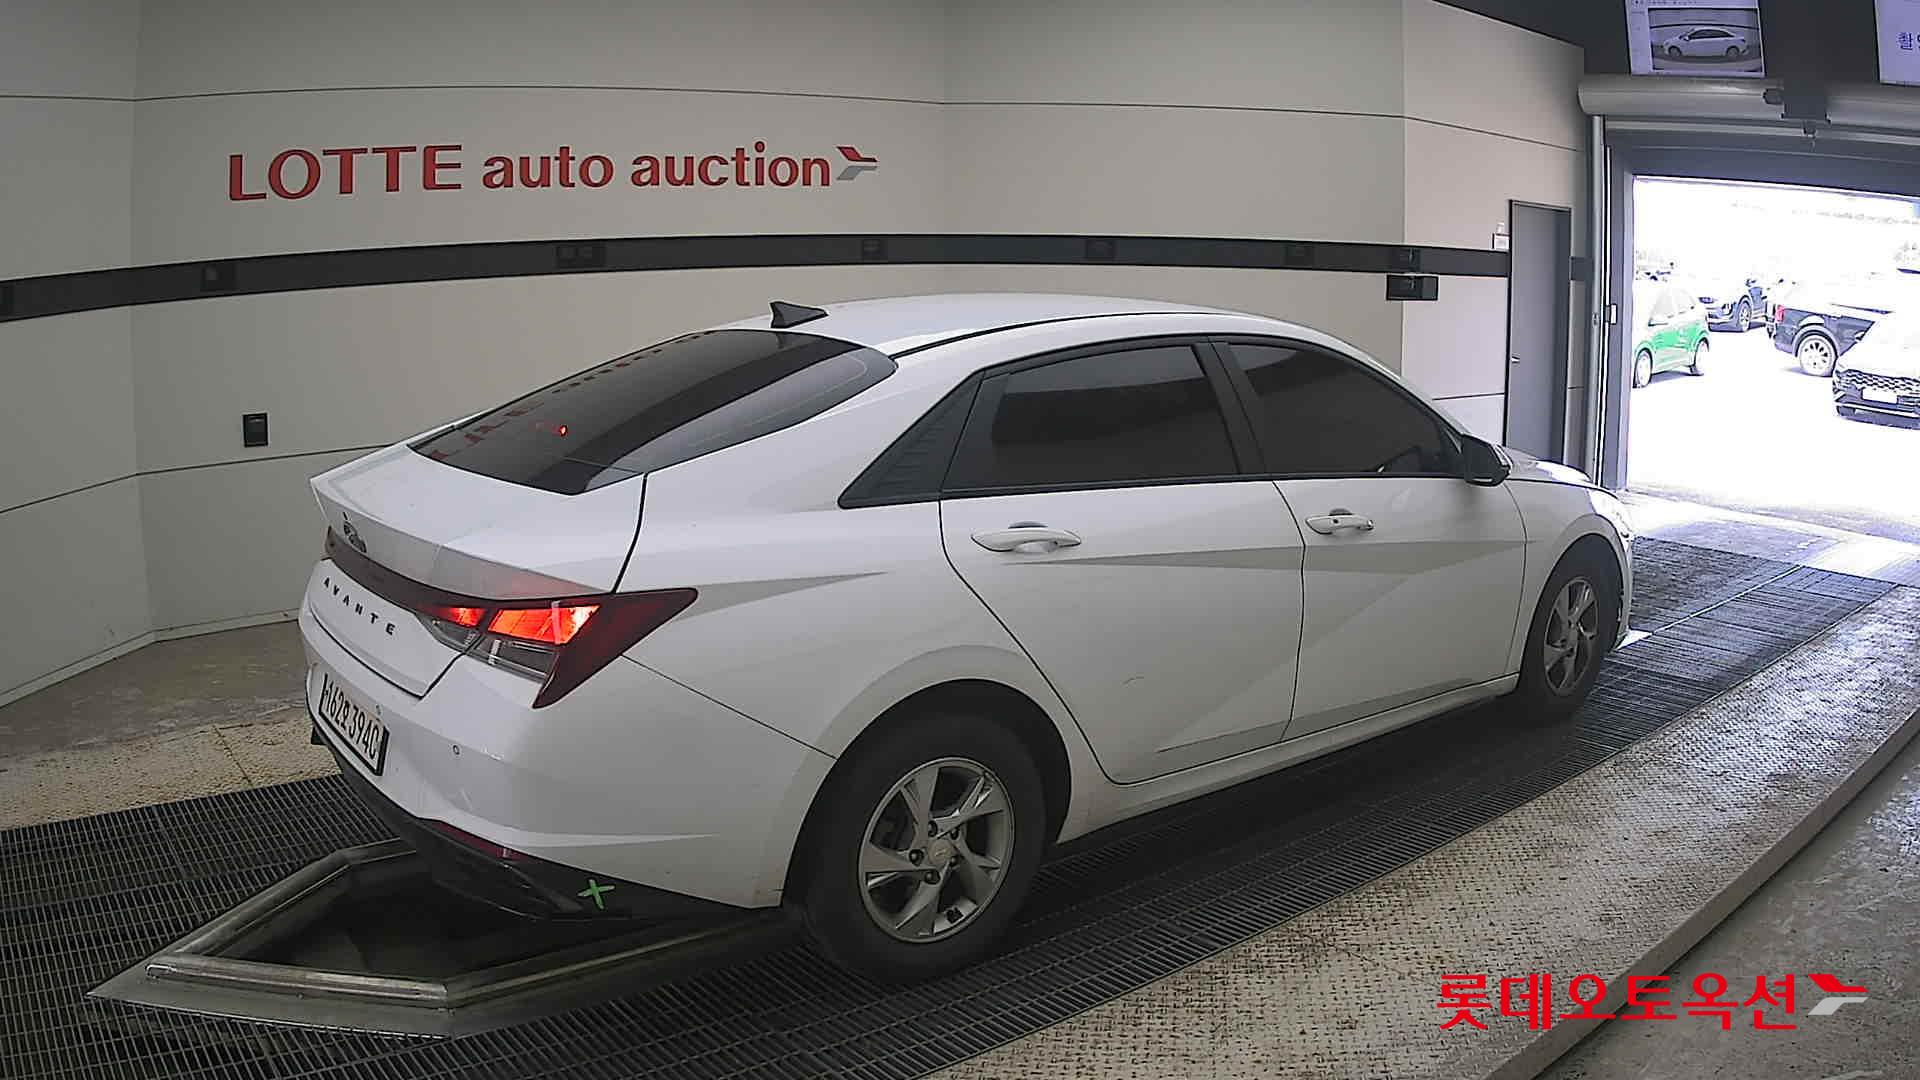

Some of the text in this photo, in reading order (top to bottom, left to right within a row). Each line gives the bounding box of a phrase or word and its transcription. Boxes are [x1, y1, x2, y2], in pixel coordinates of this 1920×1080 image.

[229, 142, 830, 200] LOTTE auto auction
[323, 577, 396, 636] AVANTE
